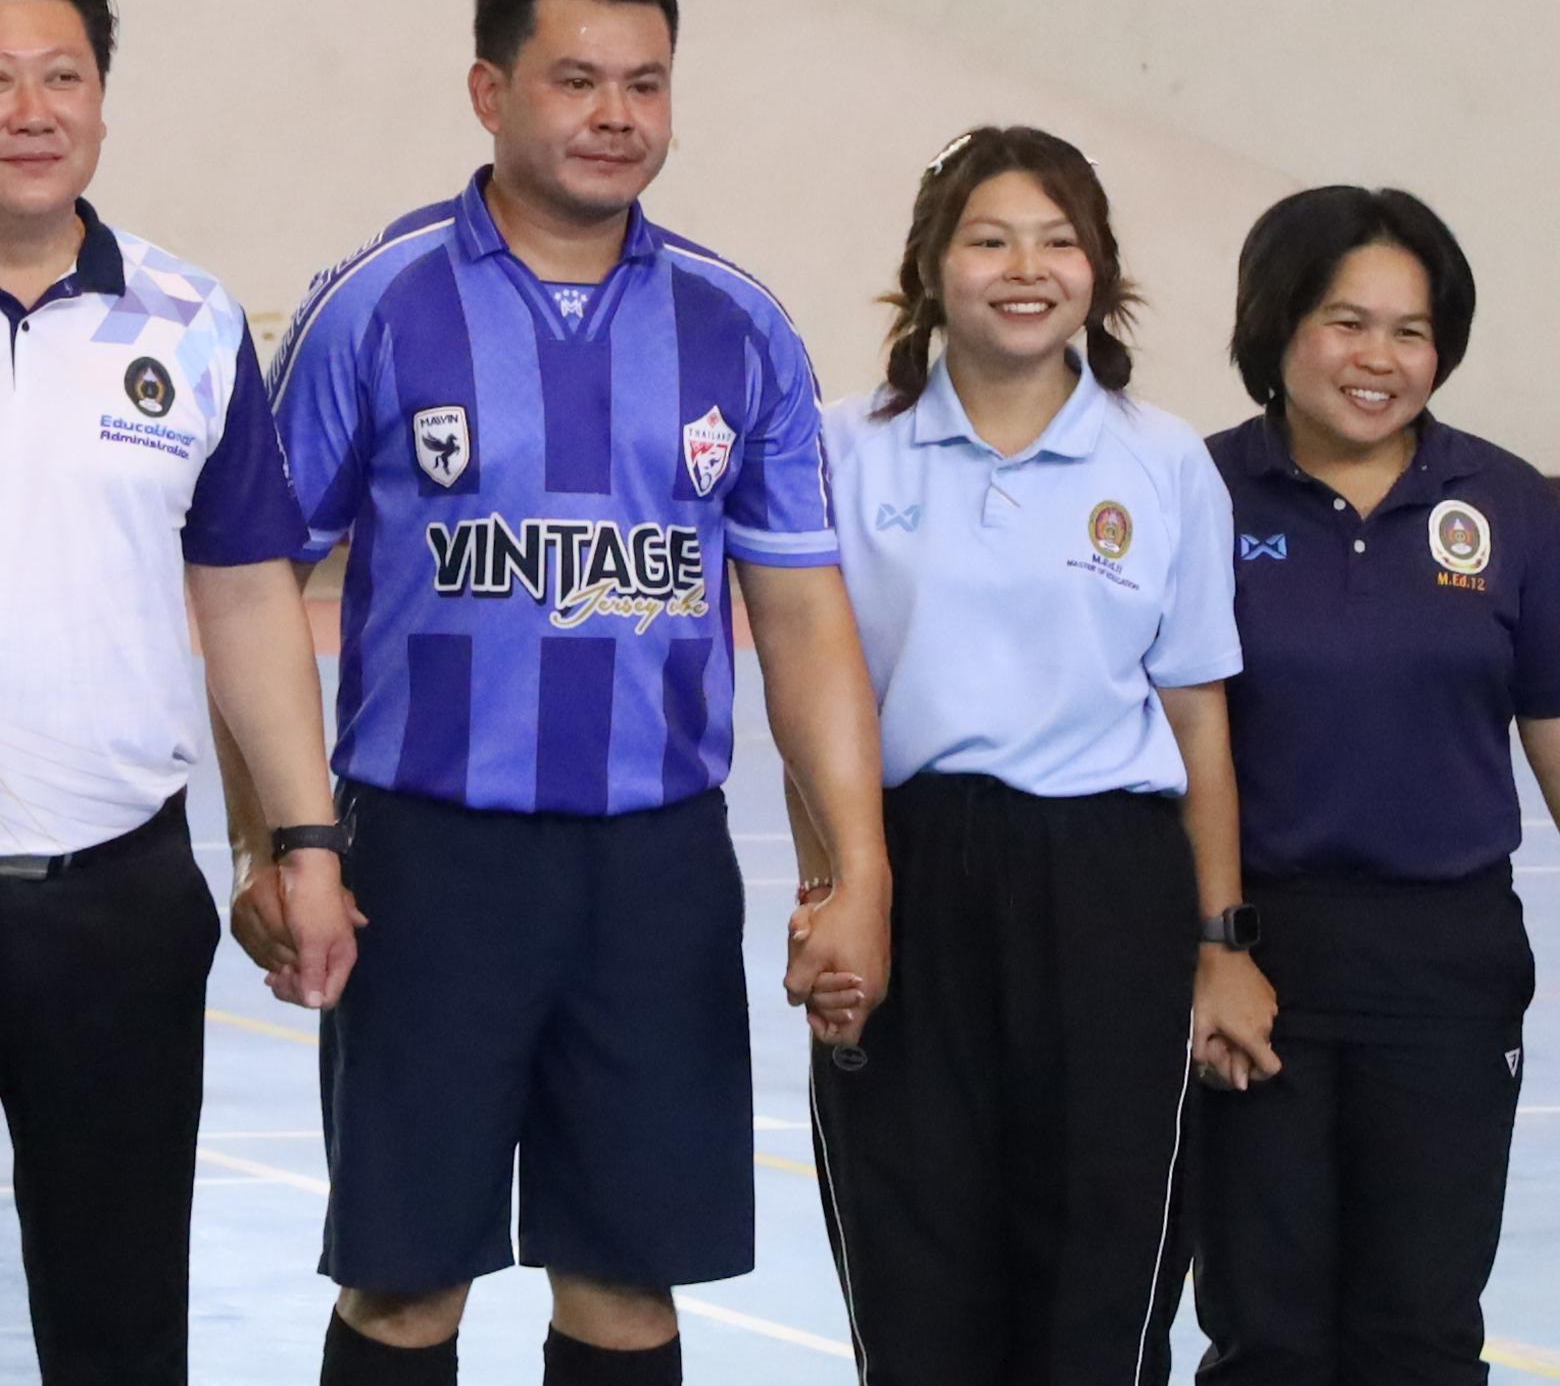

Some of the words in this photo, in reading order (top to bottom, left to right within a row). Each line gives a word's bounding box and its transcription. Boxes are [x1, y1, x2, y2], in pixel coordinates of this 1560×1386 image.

[426, 511, 704, 613] VINTAGE
[1436, 571, 1486, 591] M.Ed.12
[550, 579, 665, 635] Jersey
